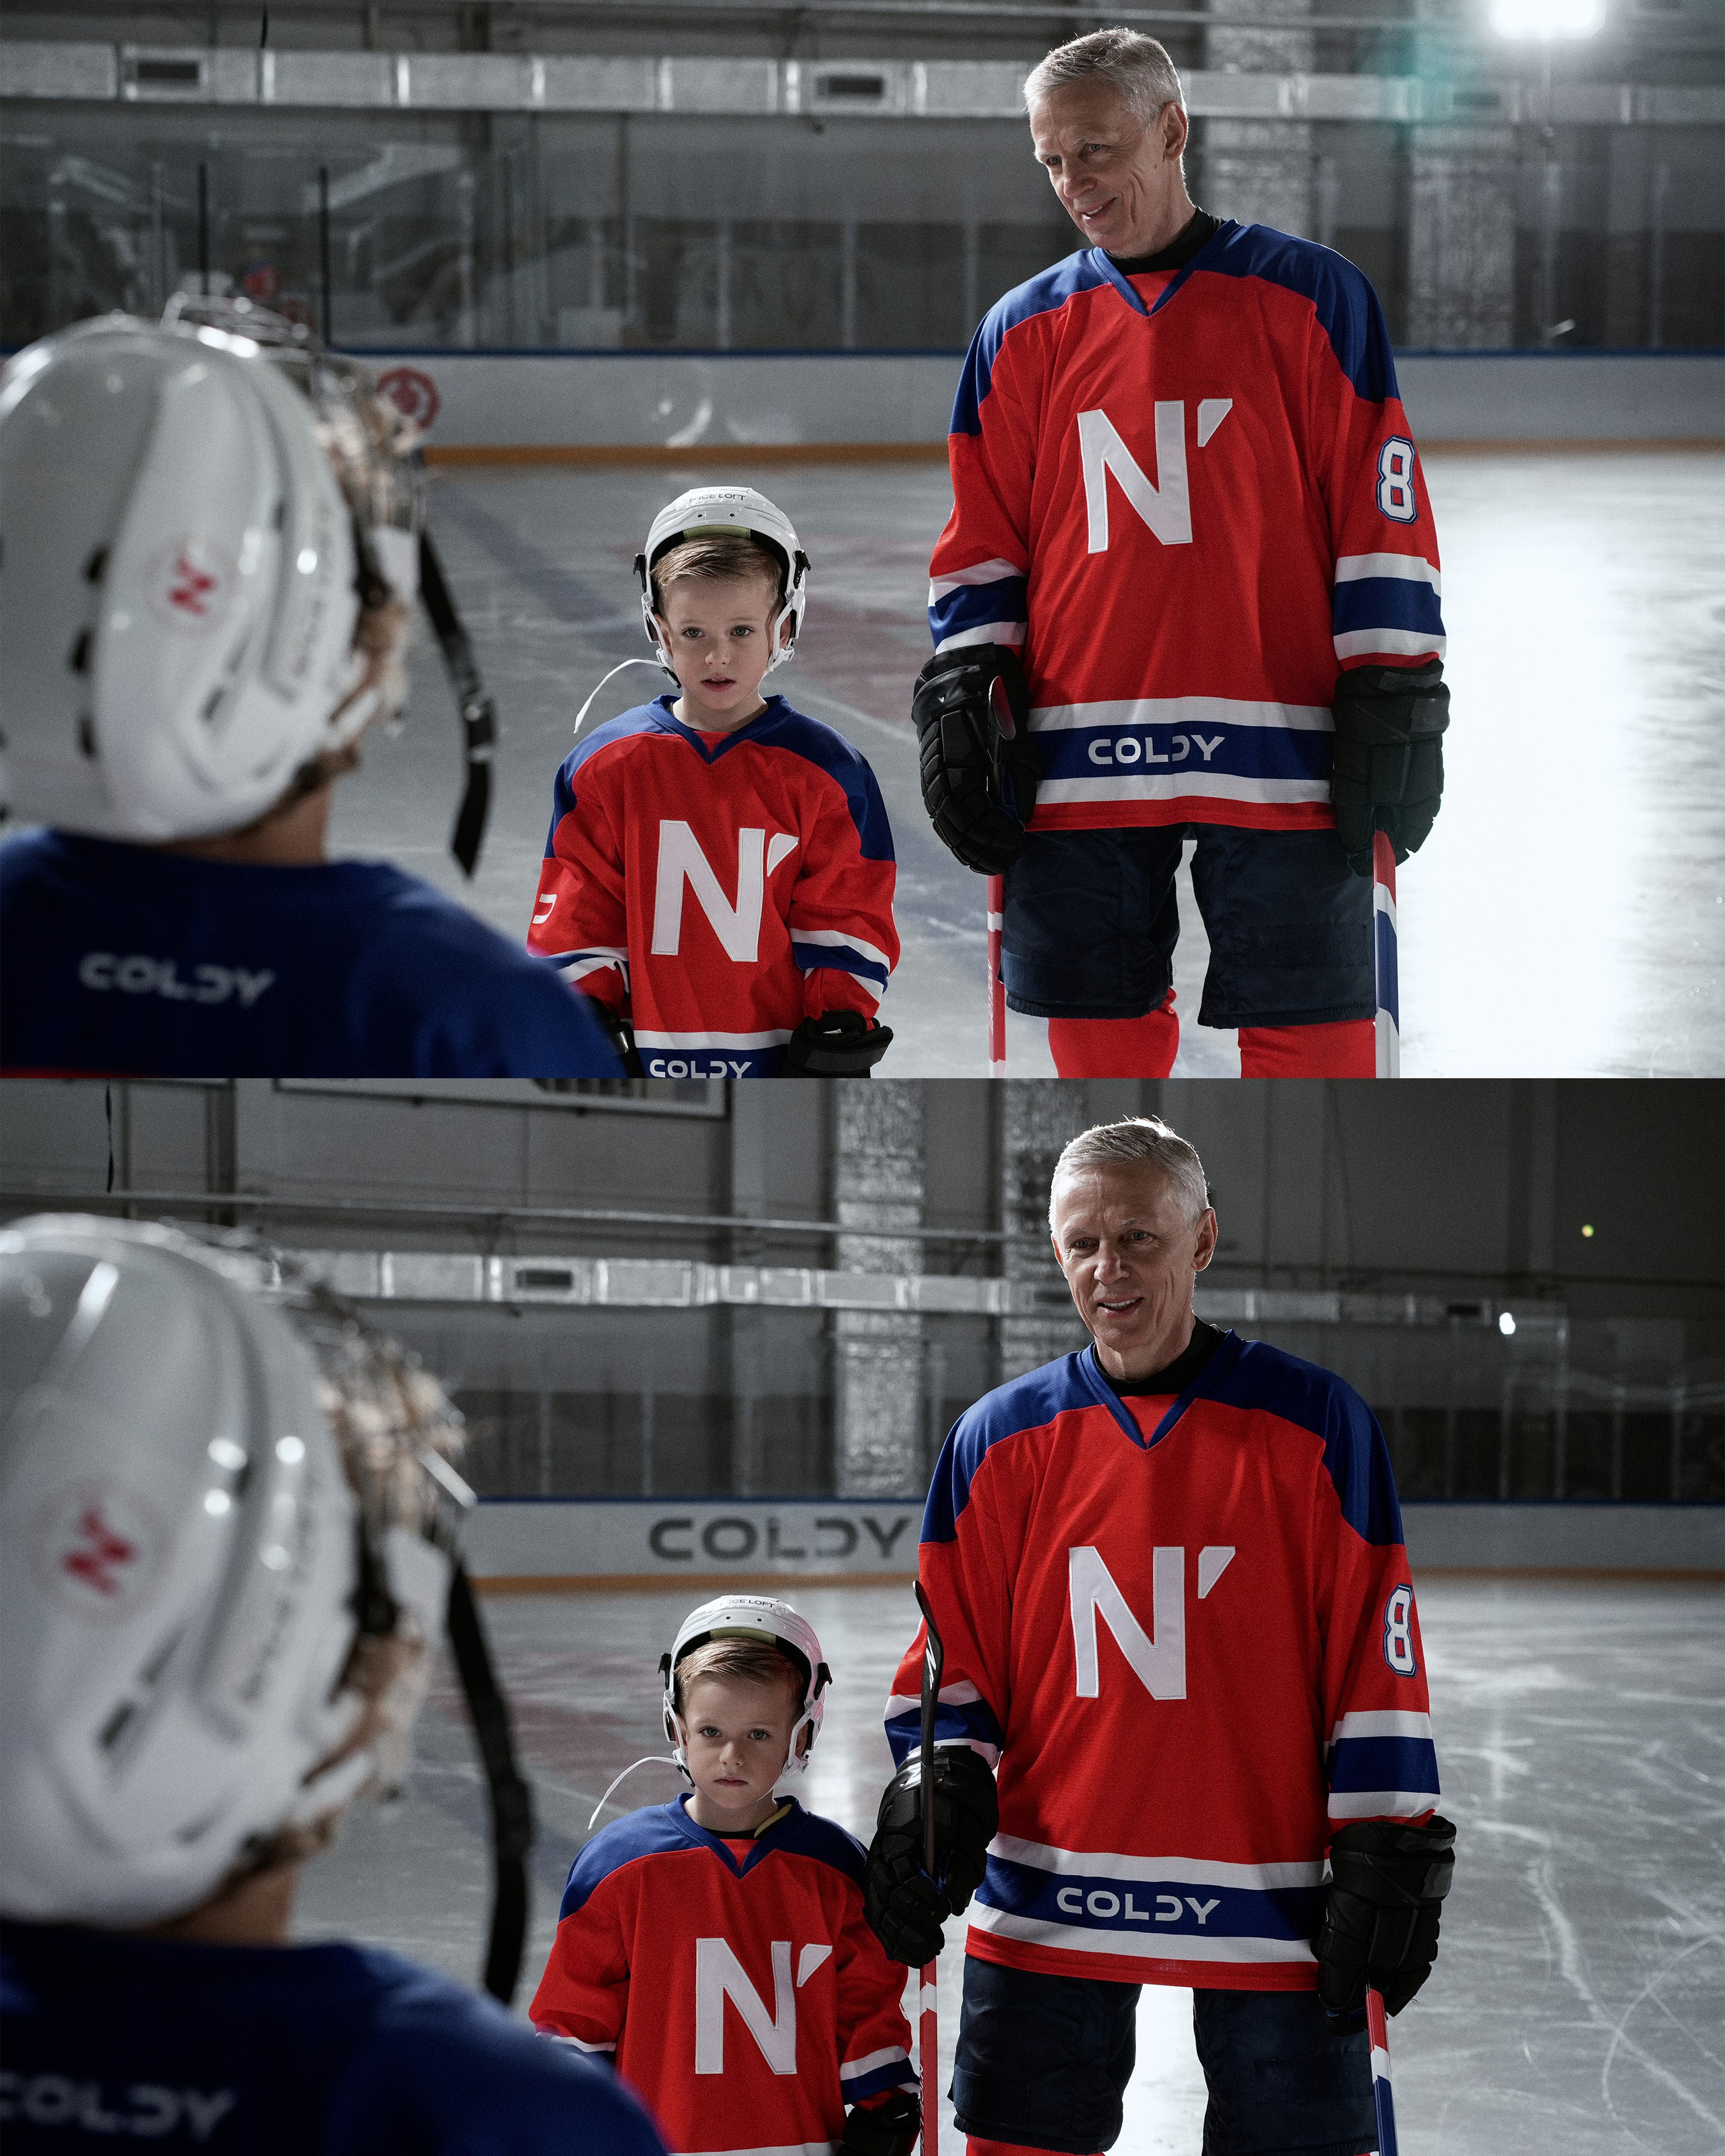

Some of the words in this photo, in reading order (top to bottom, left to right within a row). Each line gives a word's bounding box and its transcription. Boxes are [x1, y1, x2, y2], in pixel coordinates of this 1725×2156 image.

[1377, 436, 1417, 524] 8
[1088, 735, 1225, 765] COLDY
[79, 952, 275, 1008] COLDY
[649, 1058, 753, 1078] COLDY
[648, 1516, 912, 1562] COLDY
[748, 1599, 775, 1608] LOFT
[1383, 1583, 1418, 1678] 8
[1057, 1887, 1221, 1925] COLDY
